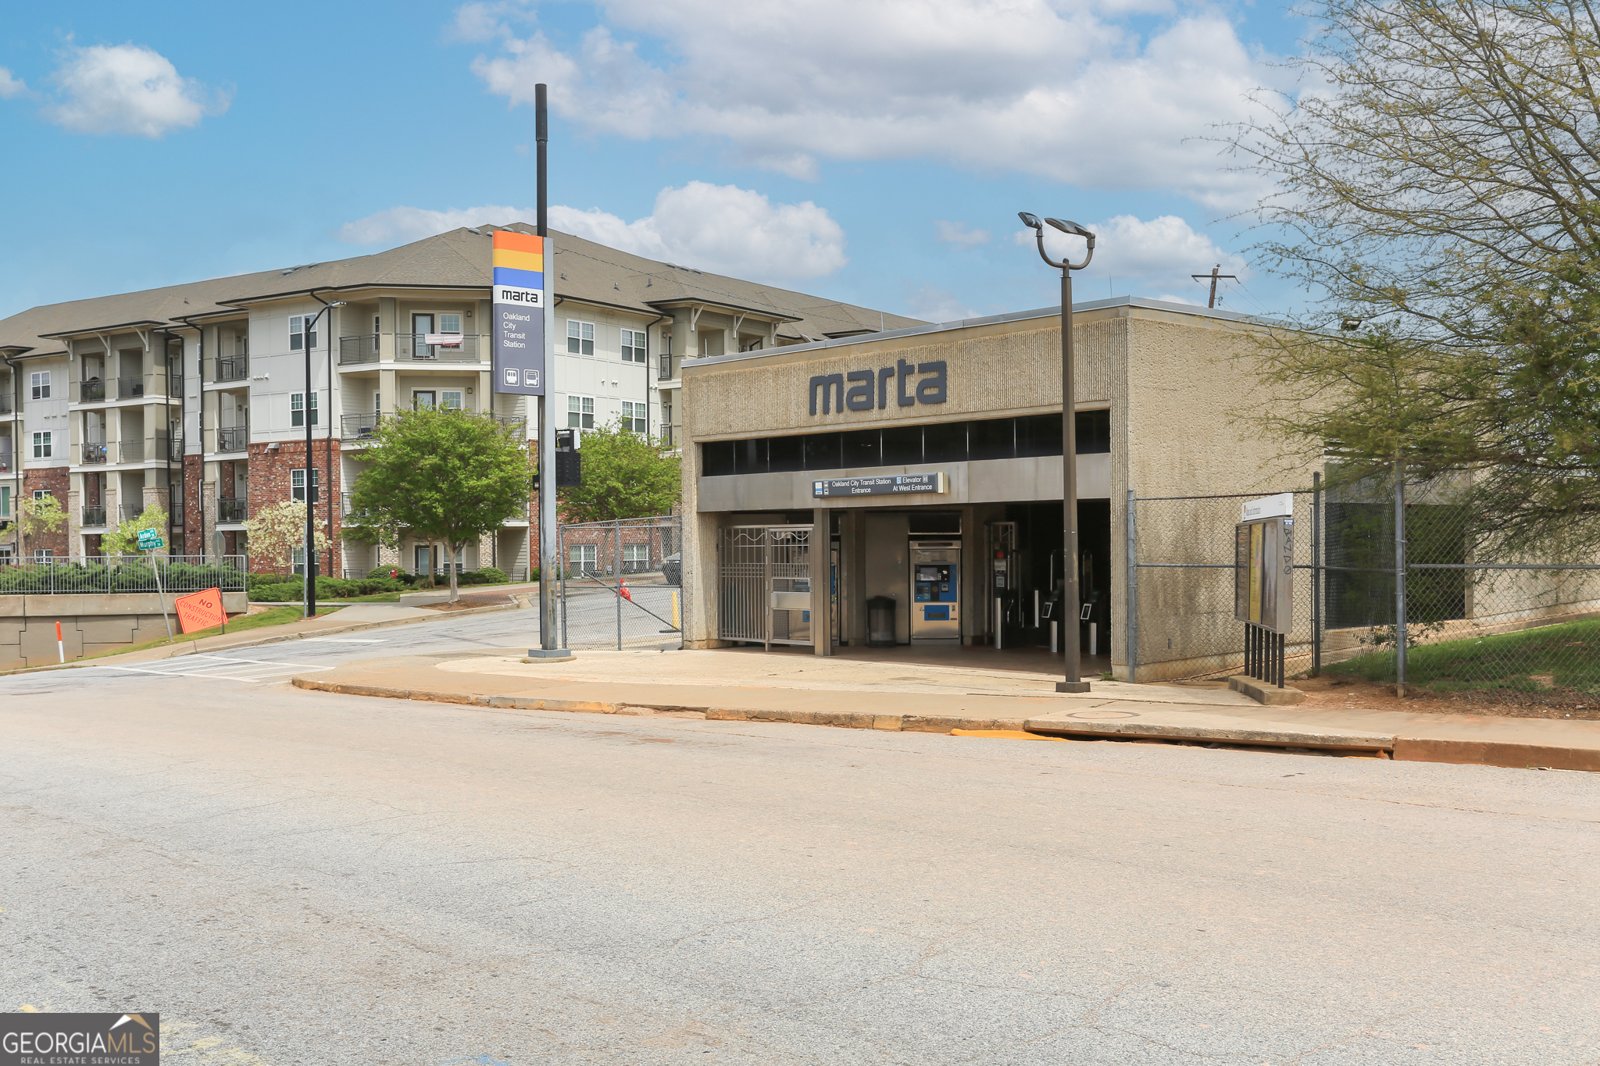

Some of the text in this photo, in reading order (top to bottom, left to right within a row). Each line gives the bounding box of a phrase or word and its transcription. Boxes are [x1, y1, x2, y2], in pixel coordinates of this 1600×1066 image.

[502, 290, 538, 303] marta
[503, 312, 530, 321] Oakland
[503, 321, 517, 330] City
[503, 331, 526, 339] Transit
[503, 340, 526, 349] Station
[809, 359, 947, 416] marta
[198, 599, 213, 609] NO
[183, 611, 209, 626] TRAFFIC
